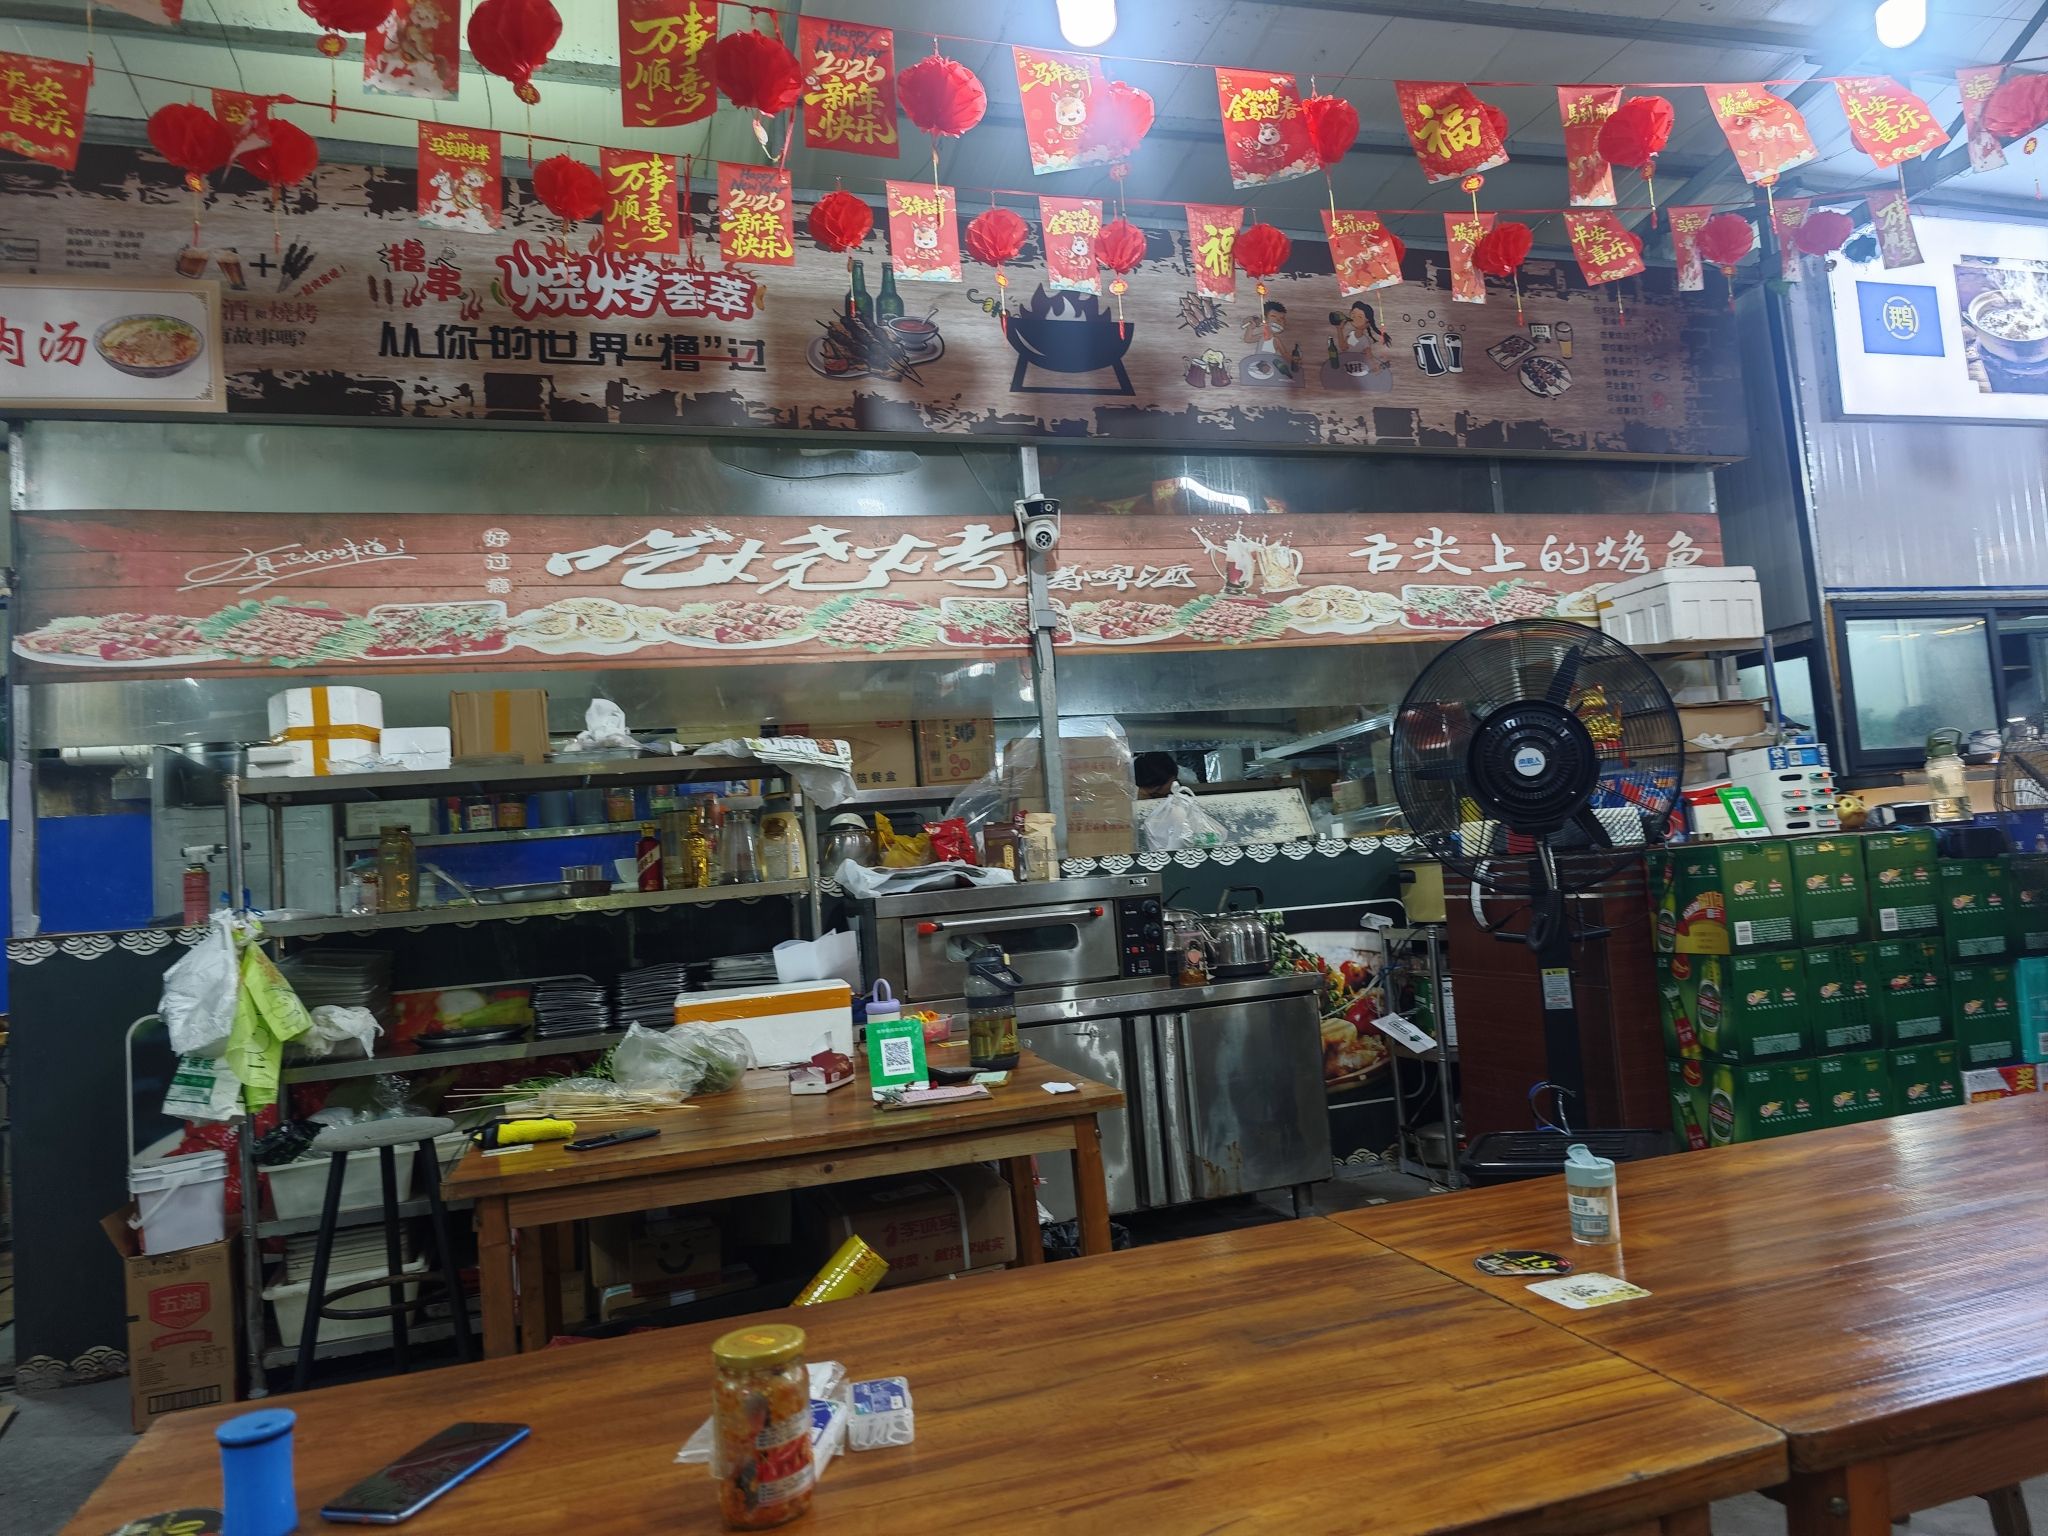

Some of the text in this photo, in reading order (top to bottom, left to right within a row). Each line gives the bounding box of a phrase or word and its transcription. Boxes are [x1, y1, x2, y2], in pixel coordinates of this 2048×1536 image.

[627, 1, 716, 64] 万事
[816, 38, 885, 58] New Year
[829, 24, 872, 41] Happy
[627, 59, 711, 105] 顺意
[815, 51, 885, 82] 2026
[1021, 61, 1095, 96] 马年吉祥
[0, 68, 67, 108] 平安
[804, 77, 885, 112] 新年
[2, 94, 76, 138] 喜乐
[819, 110, 898, 144] 快乐
[1847, 95, 1898, 127] 平安
[1869, 104, 1930, 143] 喜乐
[1415, 104, 1482, 158] 福
[608, 154, 674, 200] 万事
[740, 169, 774, 181] Happy
[729, 189, 785, 212] 2026
[607, 197, 672, 240] 顺意
[720, 209, 784, 235] 新年
[1571, 223, 1612, 249] 平安
[732, 235, 792, 259] 快乐
[1197, 224, 1235, 277] 福
[1587, 238, 1634, 266] 喜乐
[504, 248, 756, 315] 烧烤荟萃
[1886, 303, 1914, 331] 鹅
[483, 527, 512, 594] 好过瘾
[1348, 527, 1705, 575] 舌尖上的烤鱼
[159, 1291, 202, 1314] 五湖
